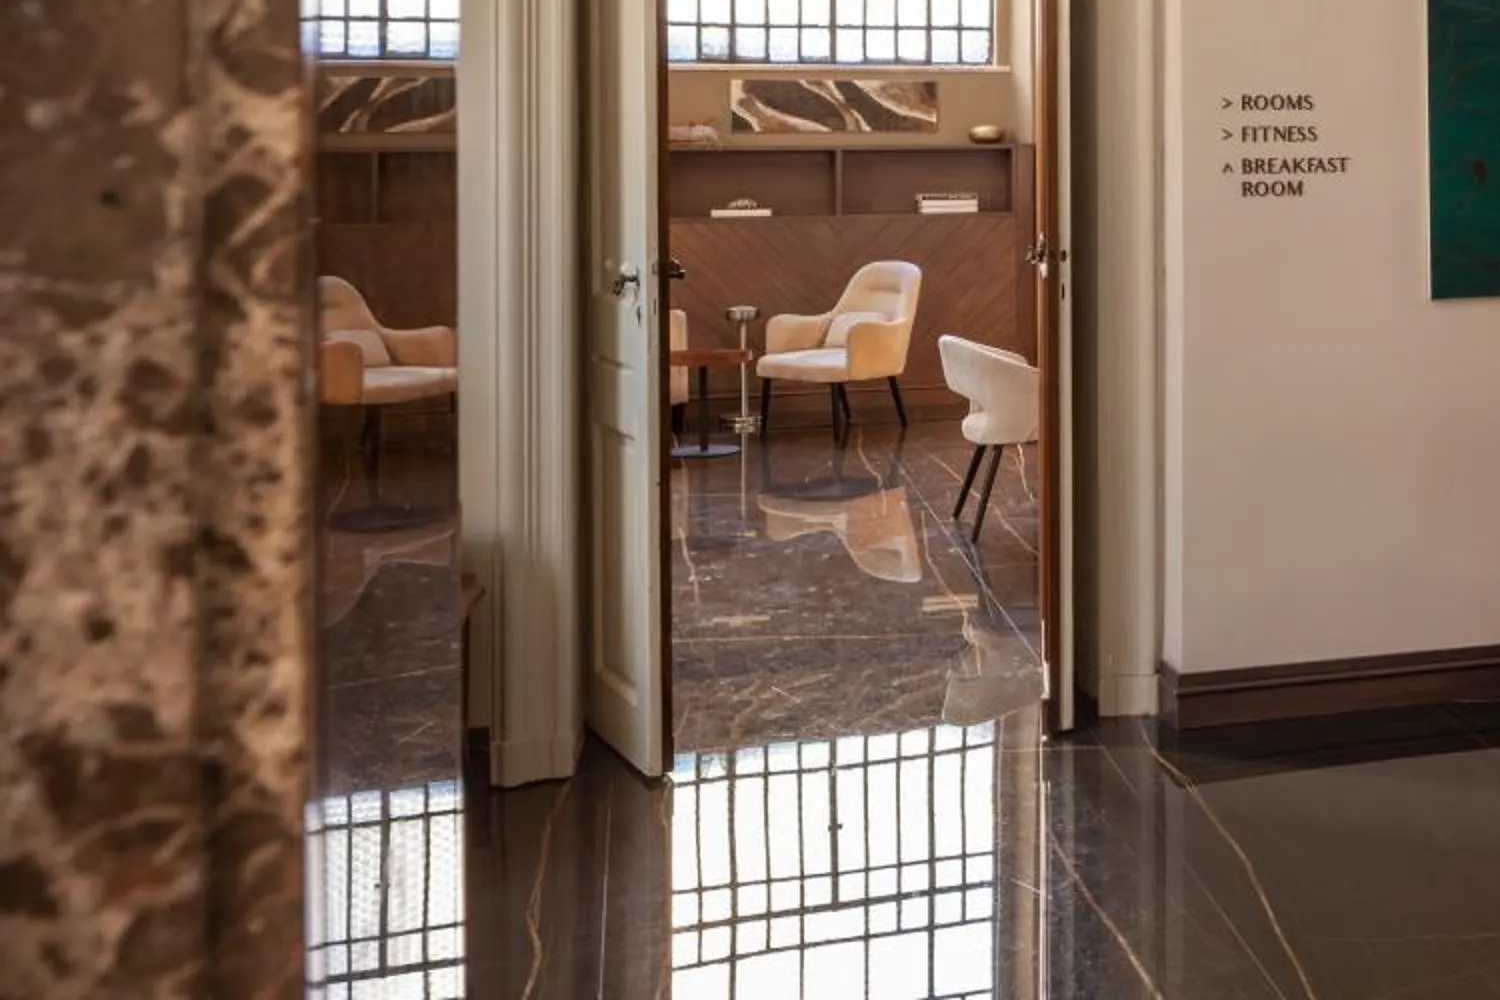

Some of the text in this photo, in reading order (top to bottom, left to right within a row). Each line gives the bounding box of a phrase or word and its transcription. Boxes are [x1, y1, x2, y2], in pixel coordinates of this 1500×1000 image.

[1241, 94, 1313, 111] ROOMS
[1241, 125, 1318, 143] FITNESS
[1241, 157, 1351, 175] BREAKFAST
[1241, 180, 1304, 197] ROOM
